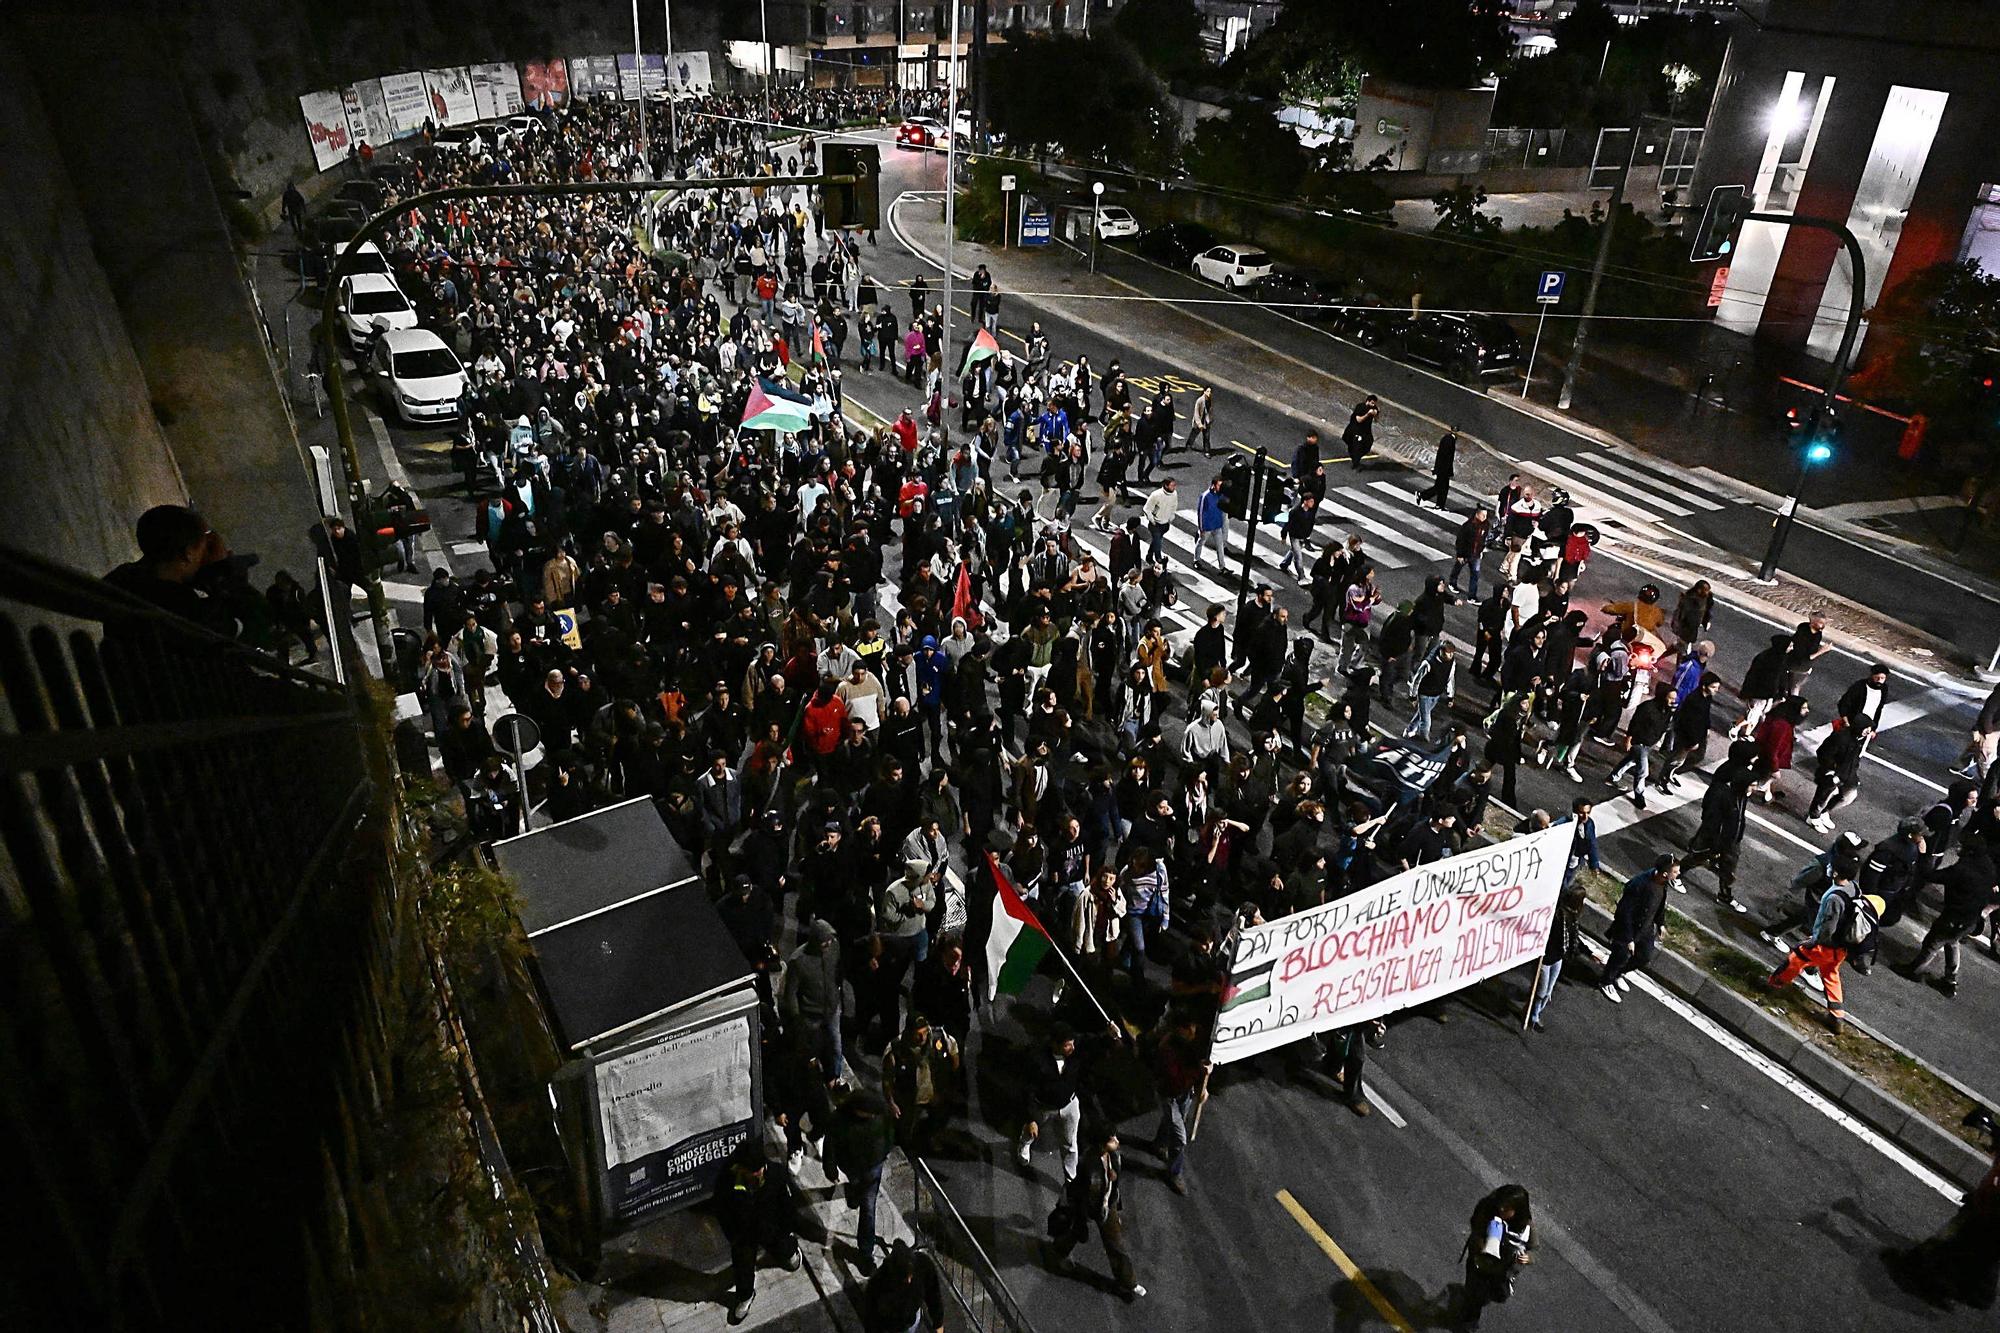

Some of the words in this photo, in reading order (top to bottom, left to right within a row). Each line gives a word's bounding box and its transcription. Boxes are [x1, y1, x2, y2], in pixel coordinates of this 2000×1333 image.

[1543, 274, 1560, 293] P
[1125, 375, 1204, 394] BUS
[1234, 929, 1274, 965] DAI
[1283, 904, 1350, 946] PORTI
[1353, 889, 1402, 924] ALLE
[1279, 900, 1450, 984] BLOCCHIAMO
[1456, 885, 1523, 927] TUTTO
[1312, 945, 1443, 1019] RESISTENZA
[667, 1138, 724, 1168] CONOSCERE
[728, 1131, 747, 1145] PER
